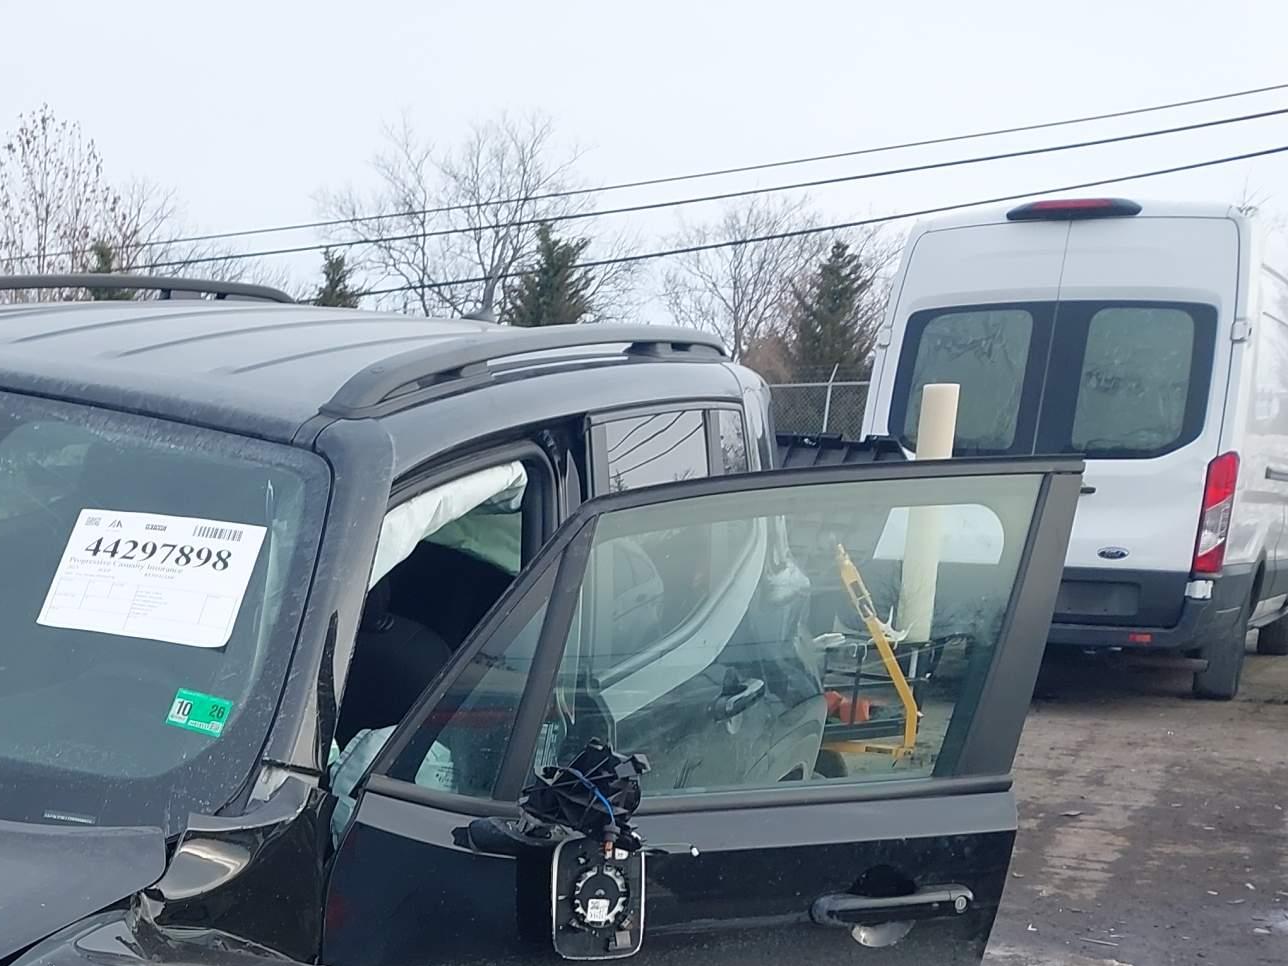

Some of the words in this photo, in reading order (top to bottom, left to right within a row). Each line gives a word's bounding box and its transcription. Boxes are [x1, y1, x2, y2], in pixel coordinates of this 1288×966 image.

[84, 536, 232, 572] 44297898
[177, 700, 193, 717] 10
[209, 704, 226, 720] 26
